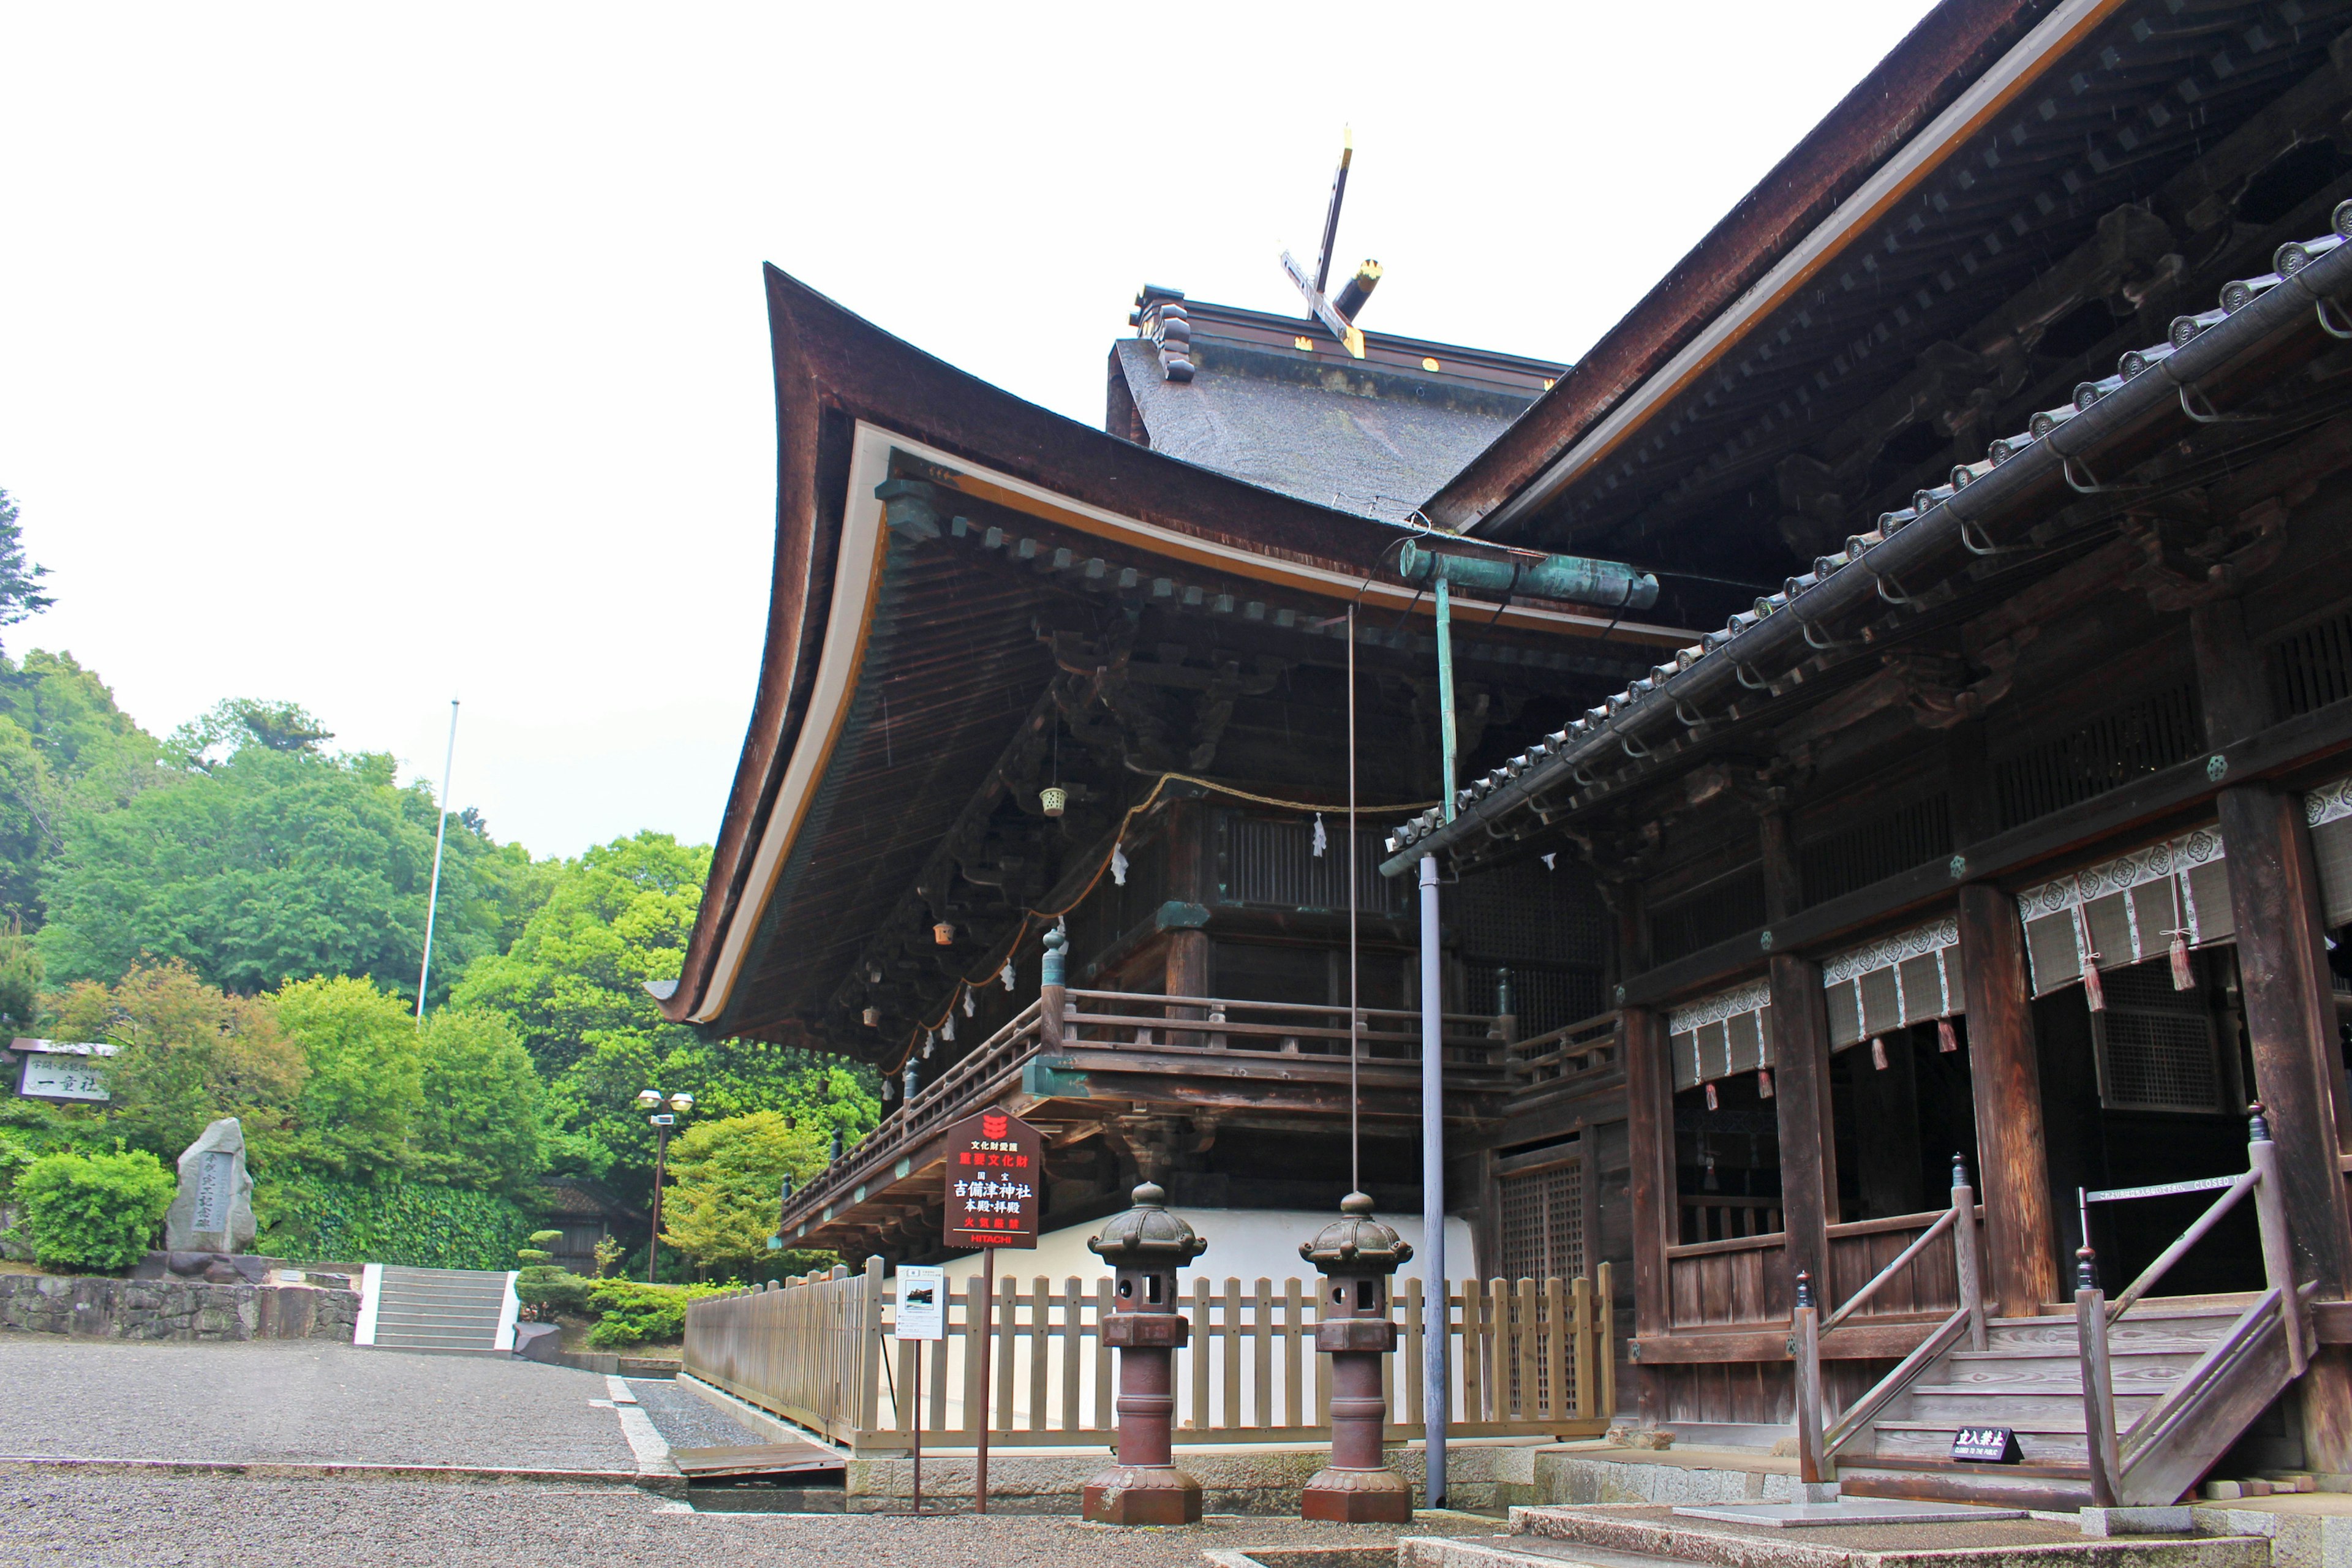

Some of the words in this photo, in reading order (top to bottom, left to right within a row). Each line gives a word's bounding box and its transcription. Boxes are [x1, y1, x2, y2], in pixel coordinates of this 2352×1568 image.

[38, 1075, 98, 1092] 一童社
[971, 1140, 1018, 1152] 文化財愛護
[960, 1152, 1028, 1167] 重要文化財
[954, 1180, 1032, 1199] 吉備津神社
[2194, 1177, 2229, 1189] CLOSED
[964, 1198, 1020, 1214] 本殿・拝殿
[964, 1216, 1020, 1229] 火気厳禁
[971, 1234, 1012, 1244] HITACHI
[1956, 1429, 2003, 1446] 立入禁止
